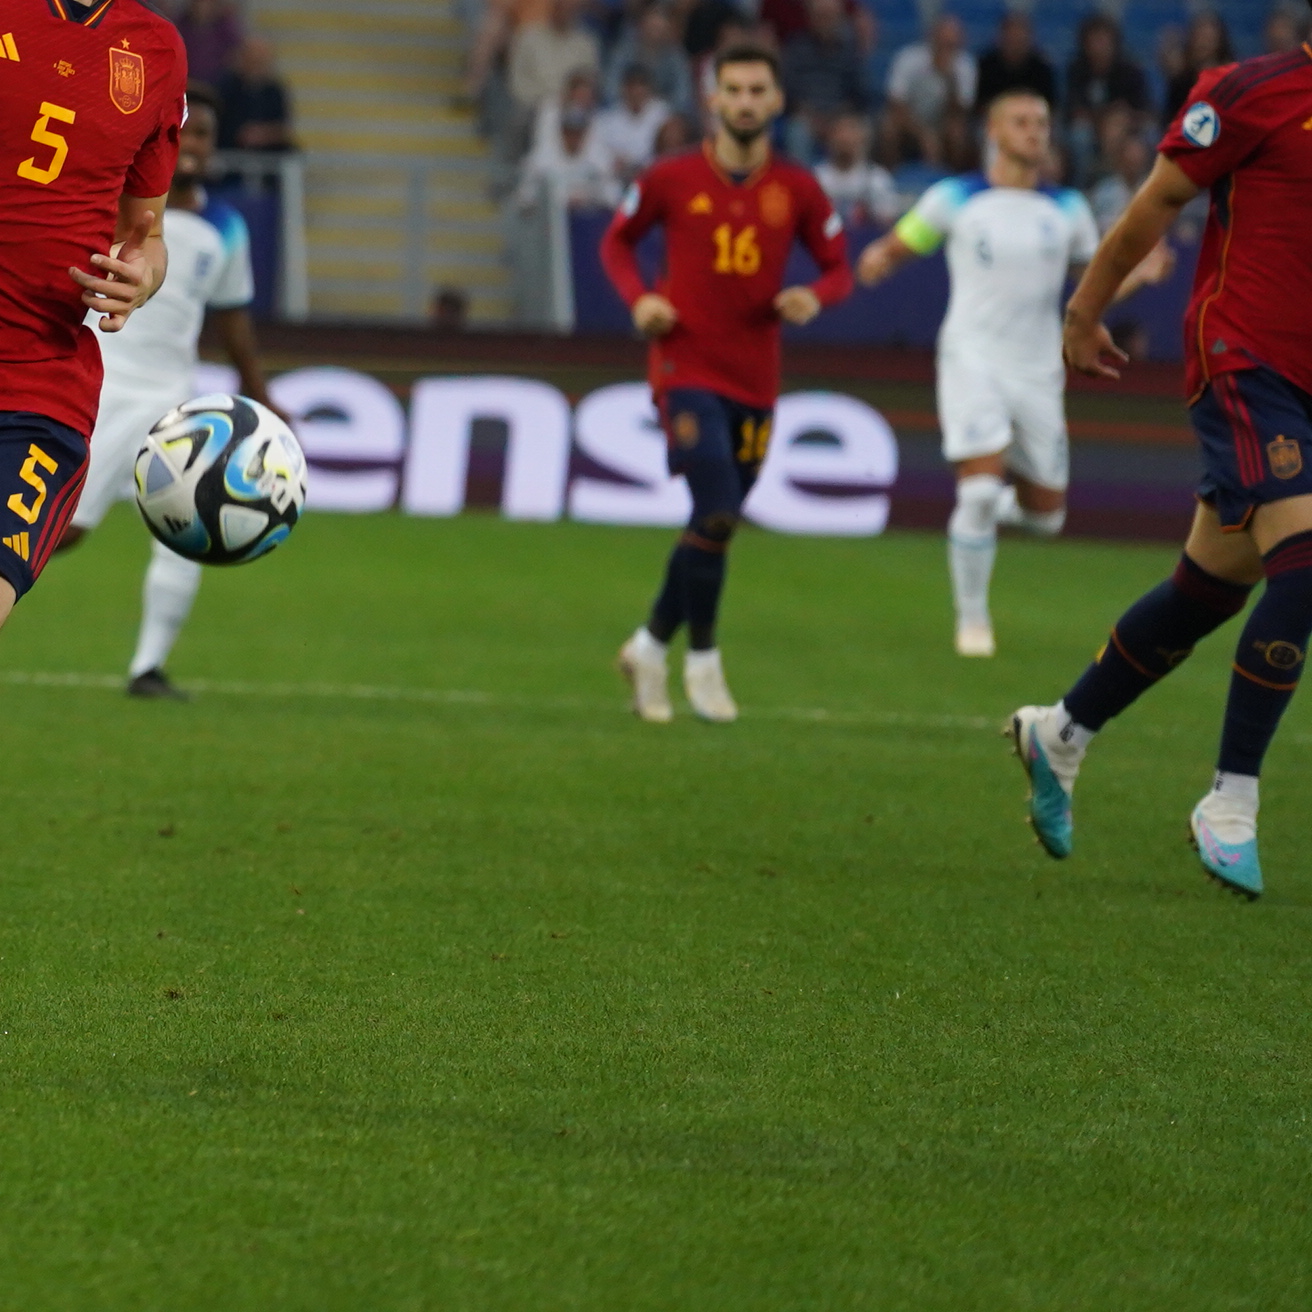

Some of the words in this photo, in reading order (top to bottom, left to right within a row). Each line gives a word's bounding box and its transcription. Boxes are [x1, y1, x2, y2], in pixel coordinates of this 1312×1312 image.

[17, 101, 76, 185] 5
[712, 222, 761, 276] 16
[7, 443, 58, 525] 5
[190, 364, 899, 538] ense
